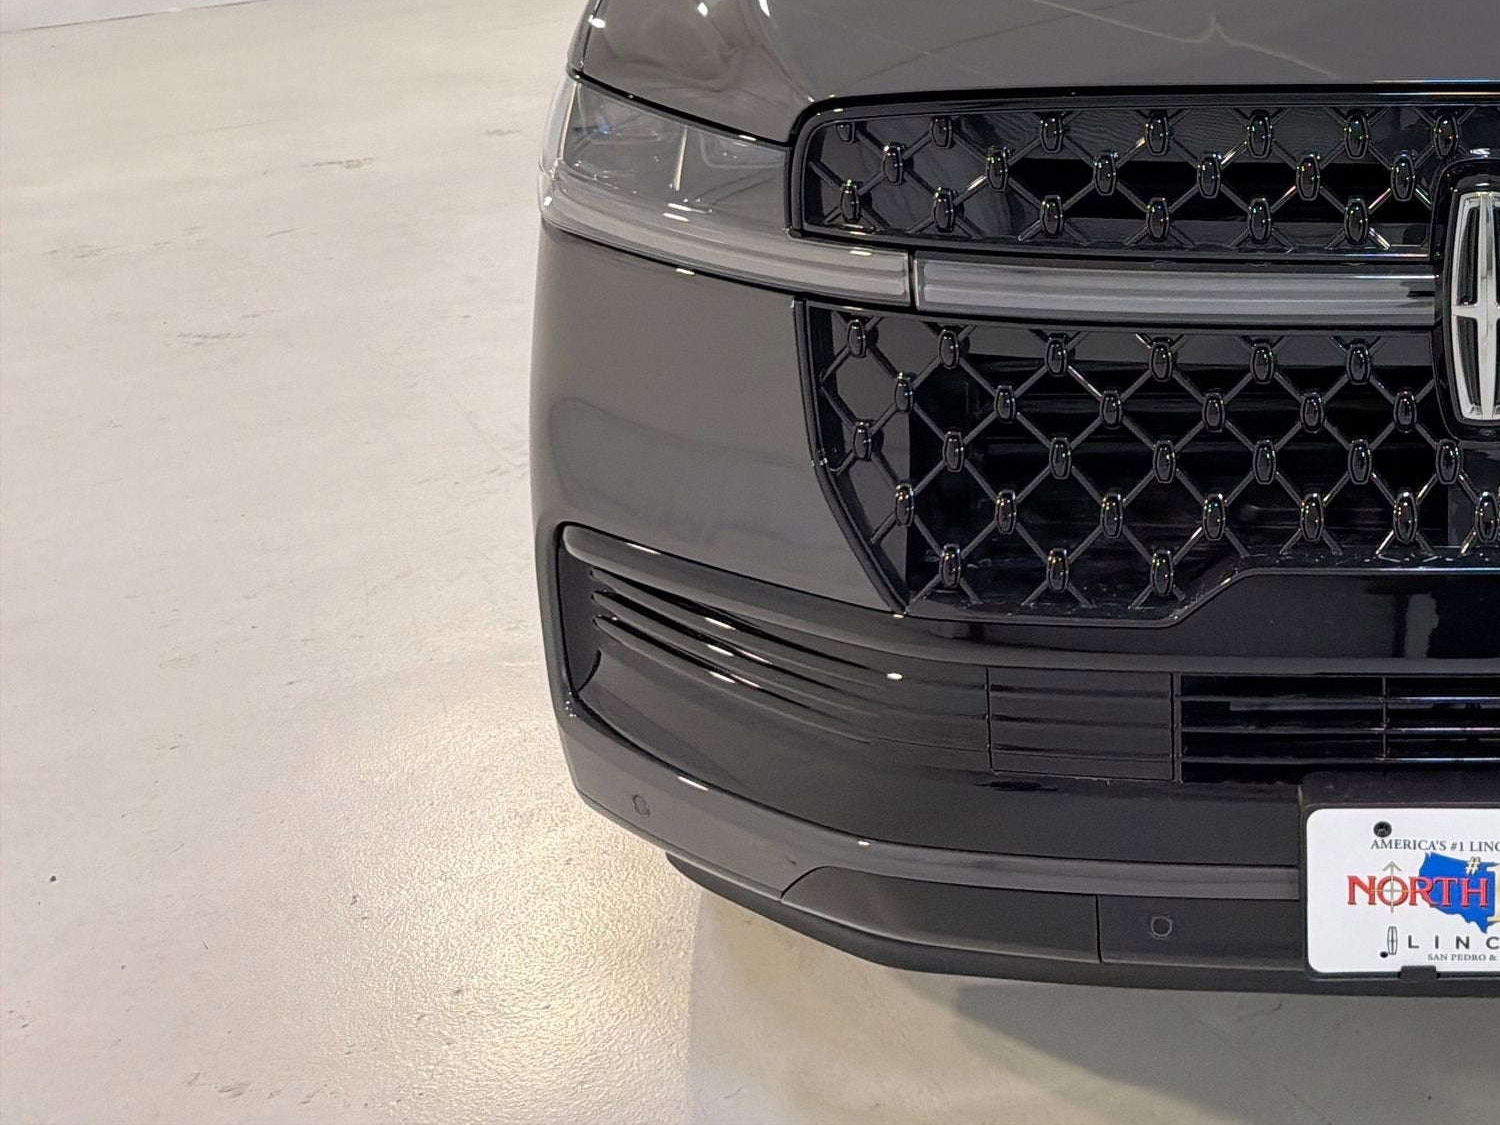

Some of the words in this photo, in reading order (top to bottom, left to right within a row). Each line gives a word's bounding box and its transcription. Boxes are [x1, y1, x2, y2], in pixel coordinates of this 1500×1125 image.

[1371, 839, 1446, 851] AMERICA'S
[1450, 840, 1465, 851] #1
[1347, 875, 1489, 907] NORTH
[1427, 953, 1449, 961] SAN
[1451, 953, 1487, 961] PEDRO
[1489, 953, 1498, 961] &
